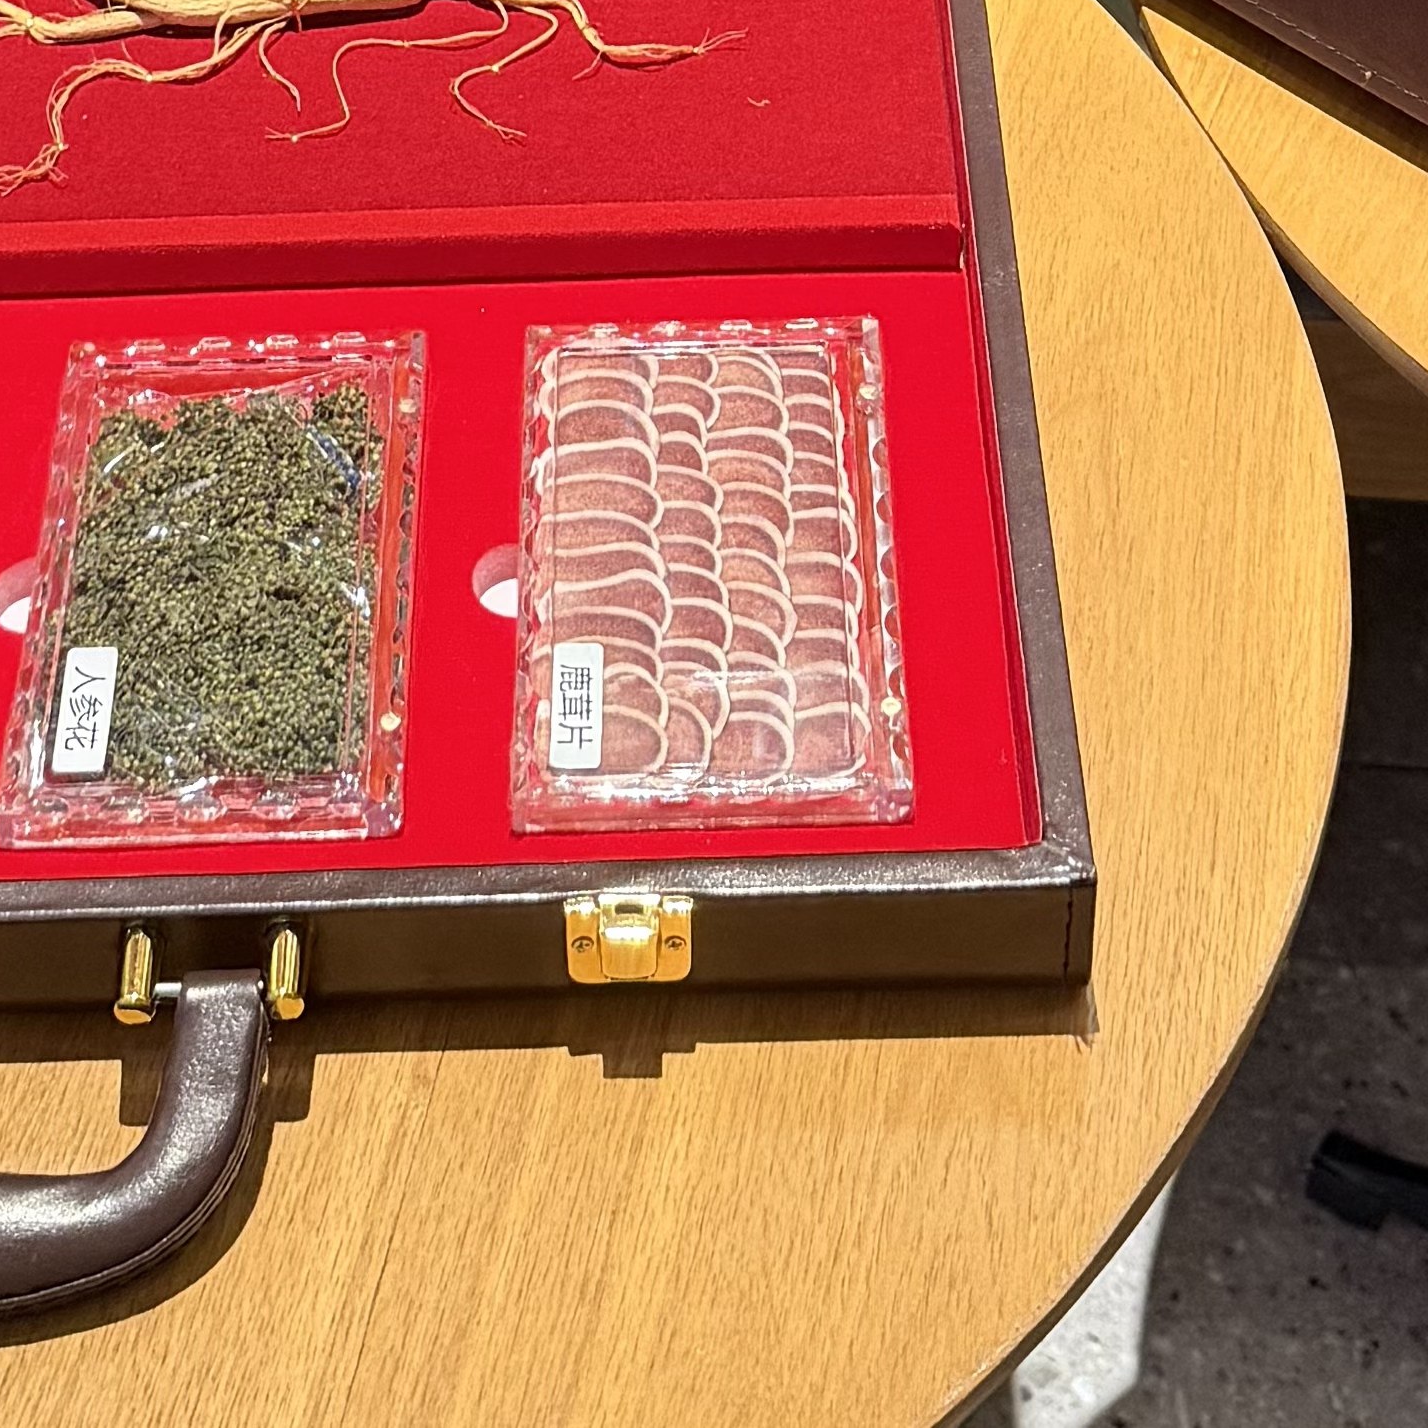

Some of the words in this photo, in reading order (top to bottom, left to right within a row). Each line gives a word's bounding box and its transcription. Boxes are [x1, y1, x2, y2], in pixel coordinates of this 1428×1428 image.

[65, 666, 106, 750] 人参花
[557, 664, 594, 749] 鹿茸片
